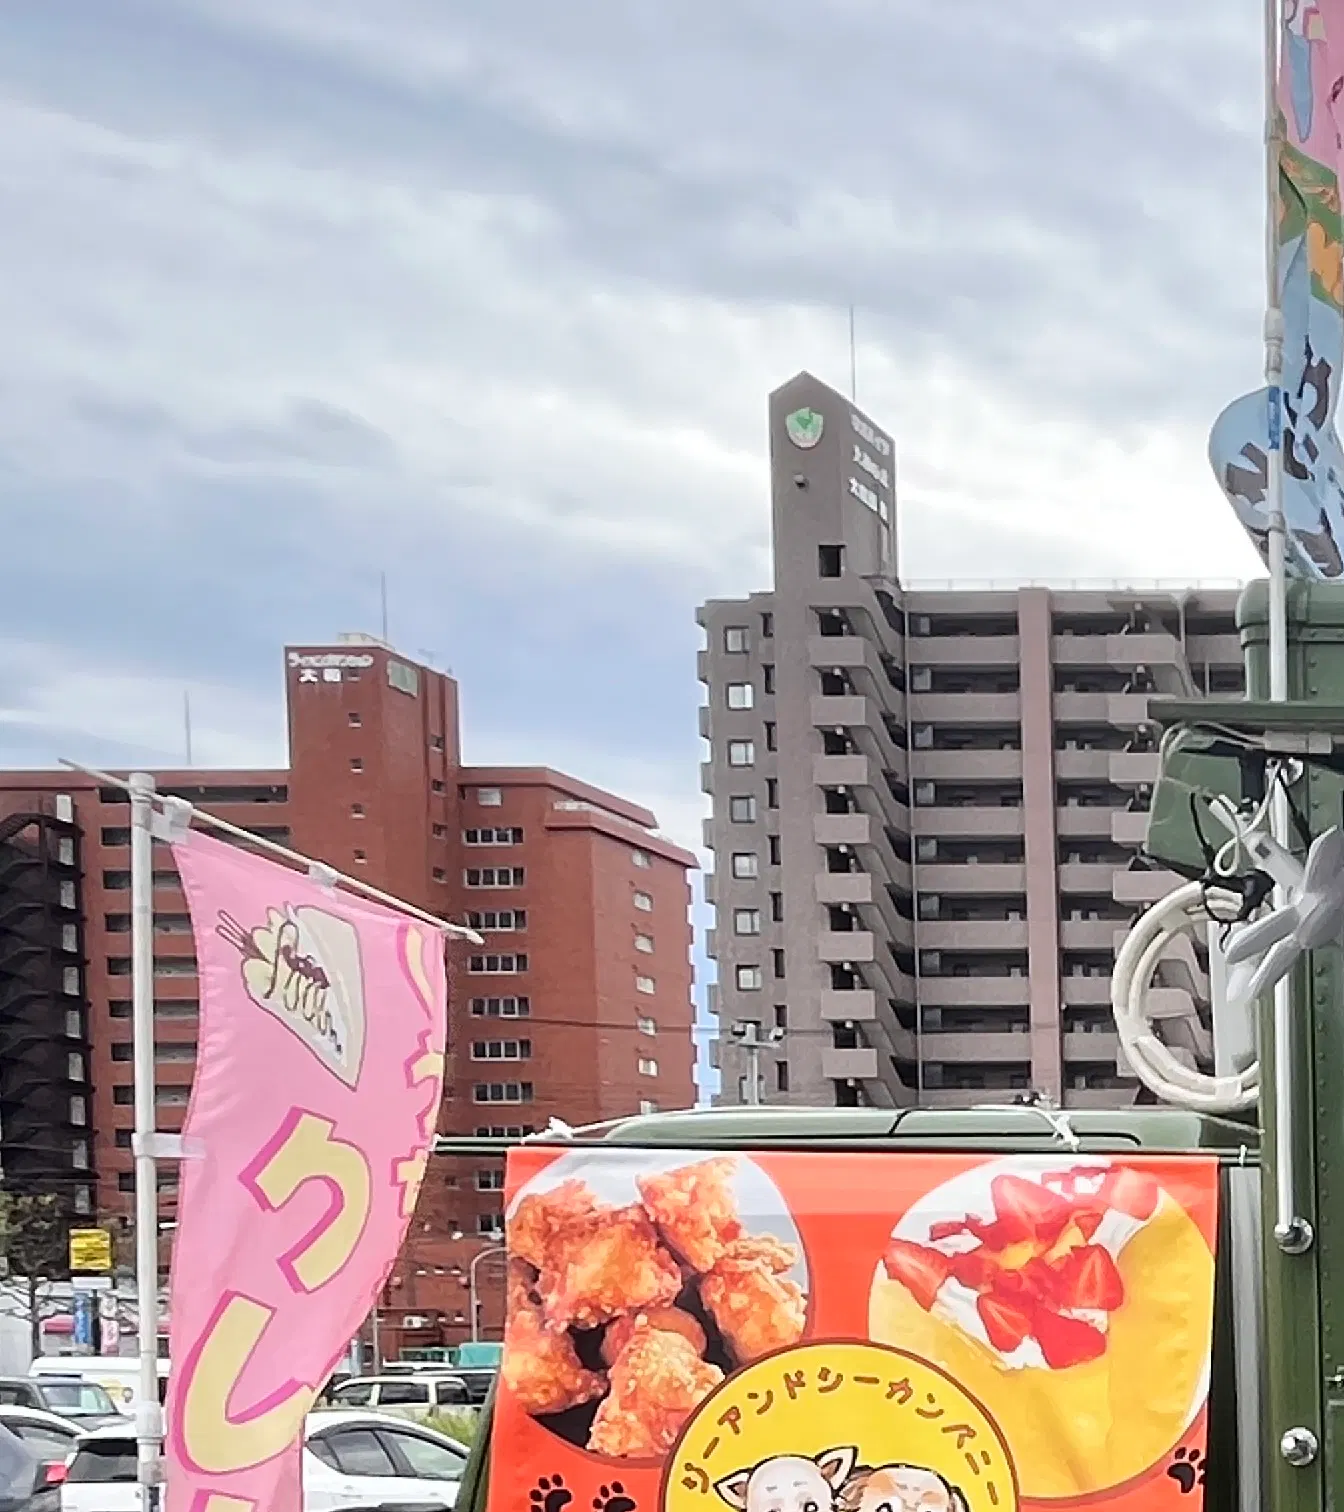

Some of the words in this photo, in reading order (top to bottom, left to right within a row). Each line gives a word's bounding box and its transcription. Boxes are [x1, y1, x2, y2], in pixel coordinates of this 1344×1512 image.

[682, 1367, 999, 1505] ジーアンドシーカンパニー
